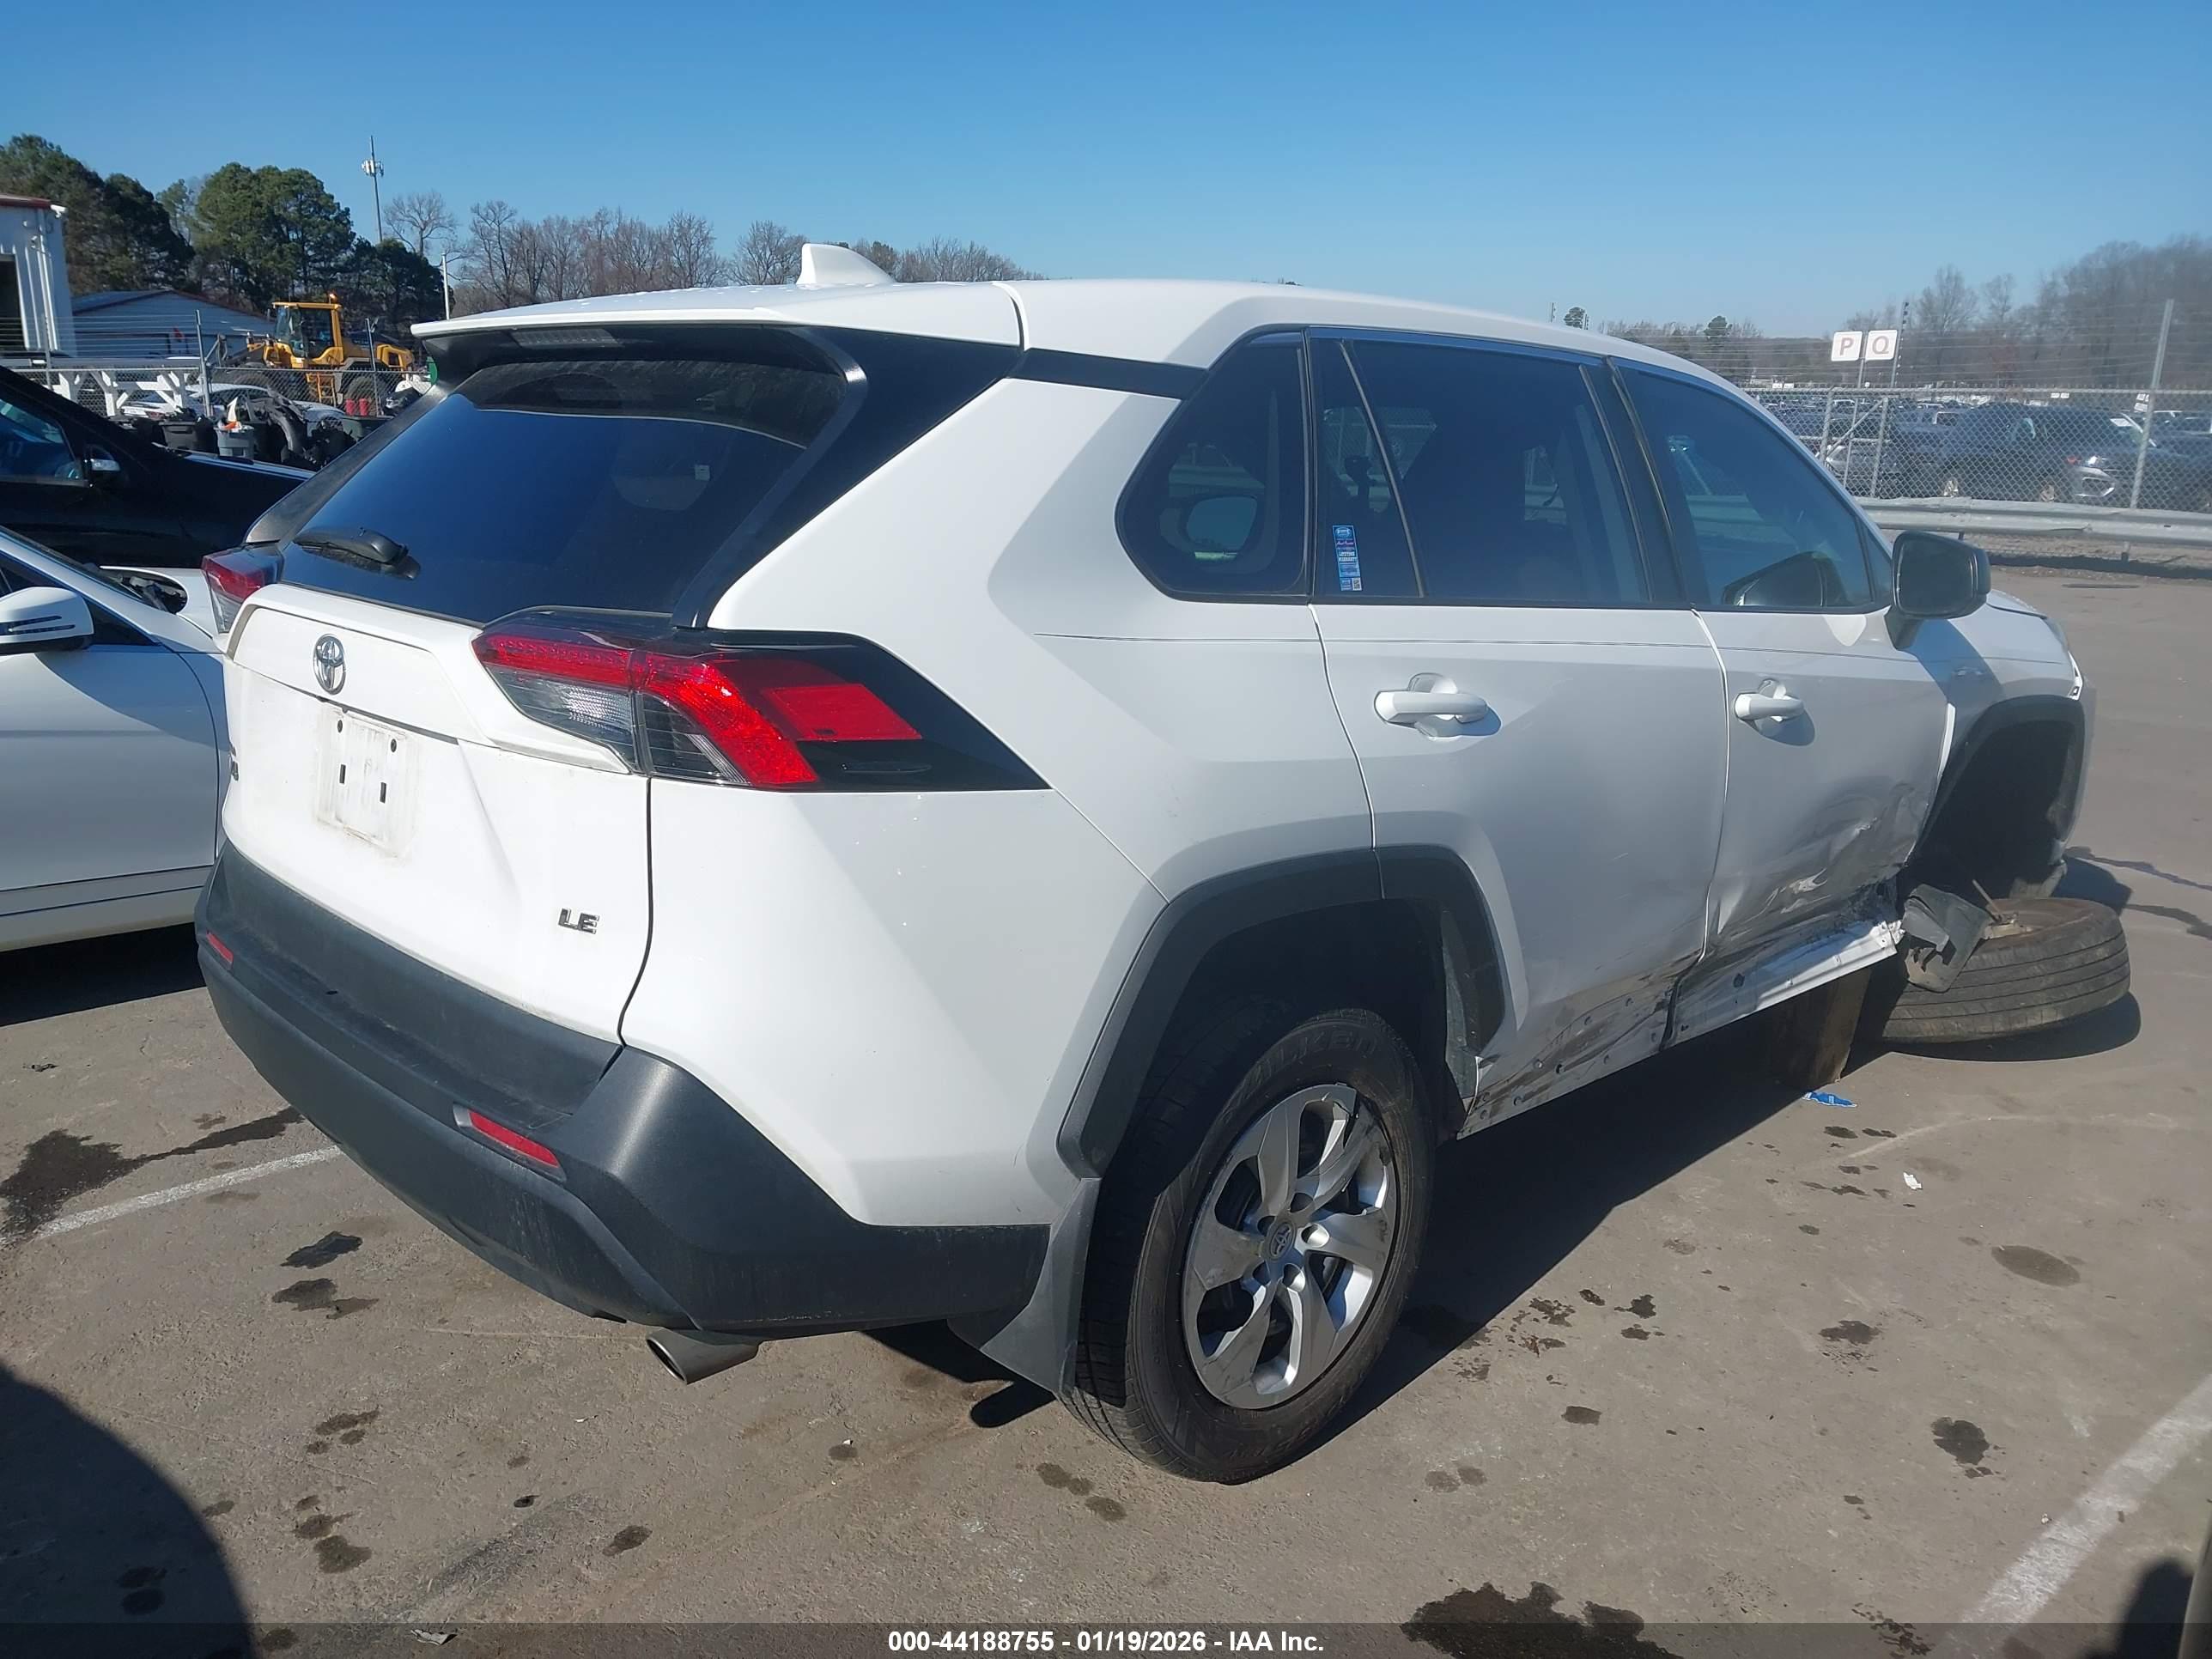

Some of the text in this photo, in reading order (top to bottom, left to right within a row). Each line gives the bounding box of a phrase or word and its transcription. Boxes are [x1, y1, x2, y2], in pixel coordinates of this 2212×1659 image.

[1840, 337, 1855, 356] P
[1872, 336, 1890, 355] Q
[558, 908, 600, 934] LE
